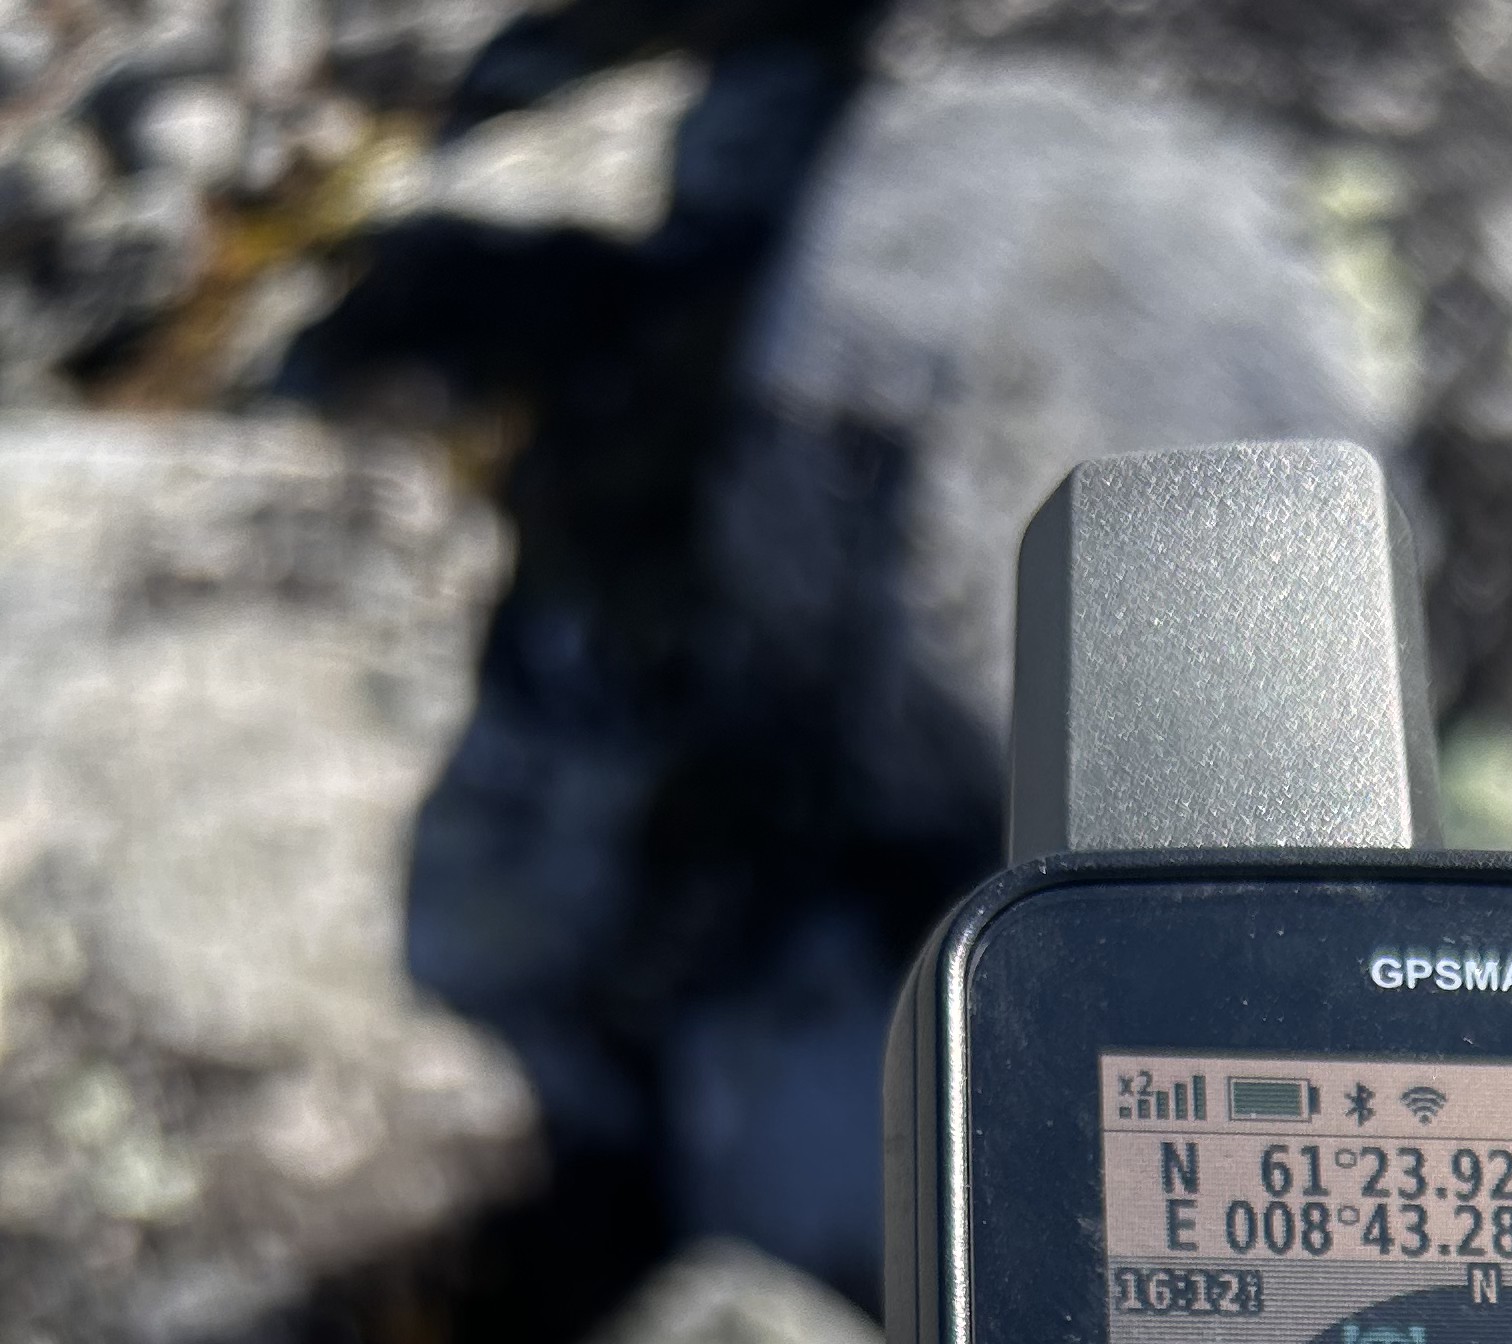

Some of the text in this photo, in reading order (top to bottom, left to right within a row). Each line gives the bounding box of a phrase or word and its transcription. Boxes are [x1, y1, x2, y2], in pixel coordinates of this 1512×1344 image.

[1161, 1141, 1199, 1194] N
[1166, 1199, 1199, 1251] E
[1472, 1269, 1497, 1303] N
